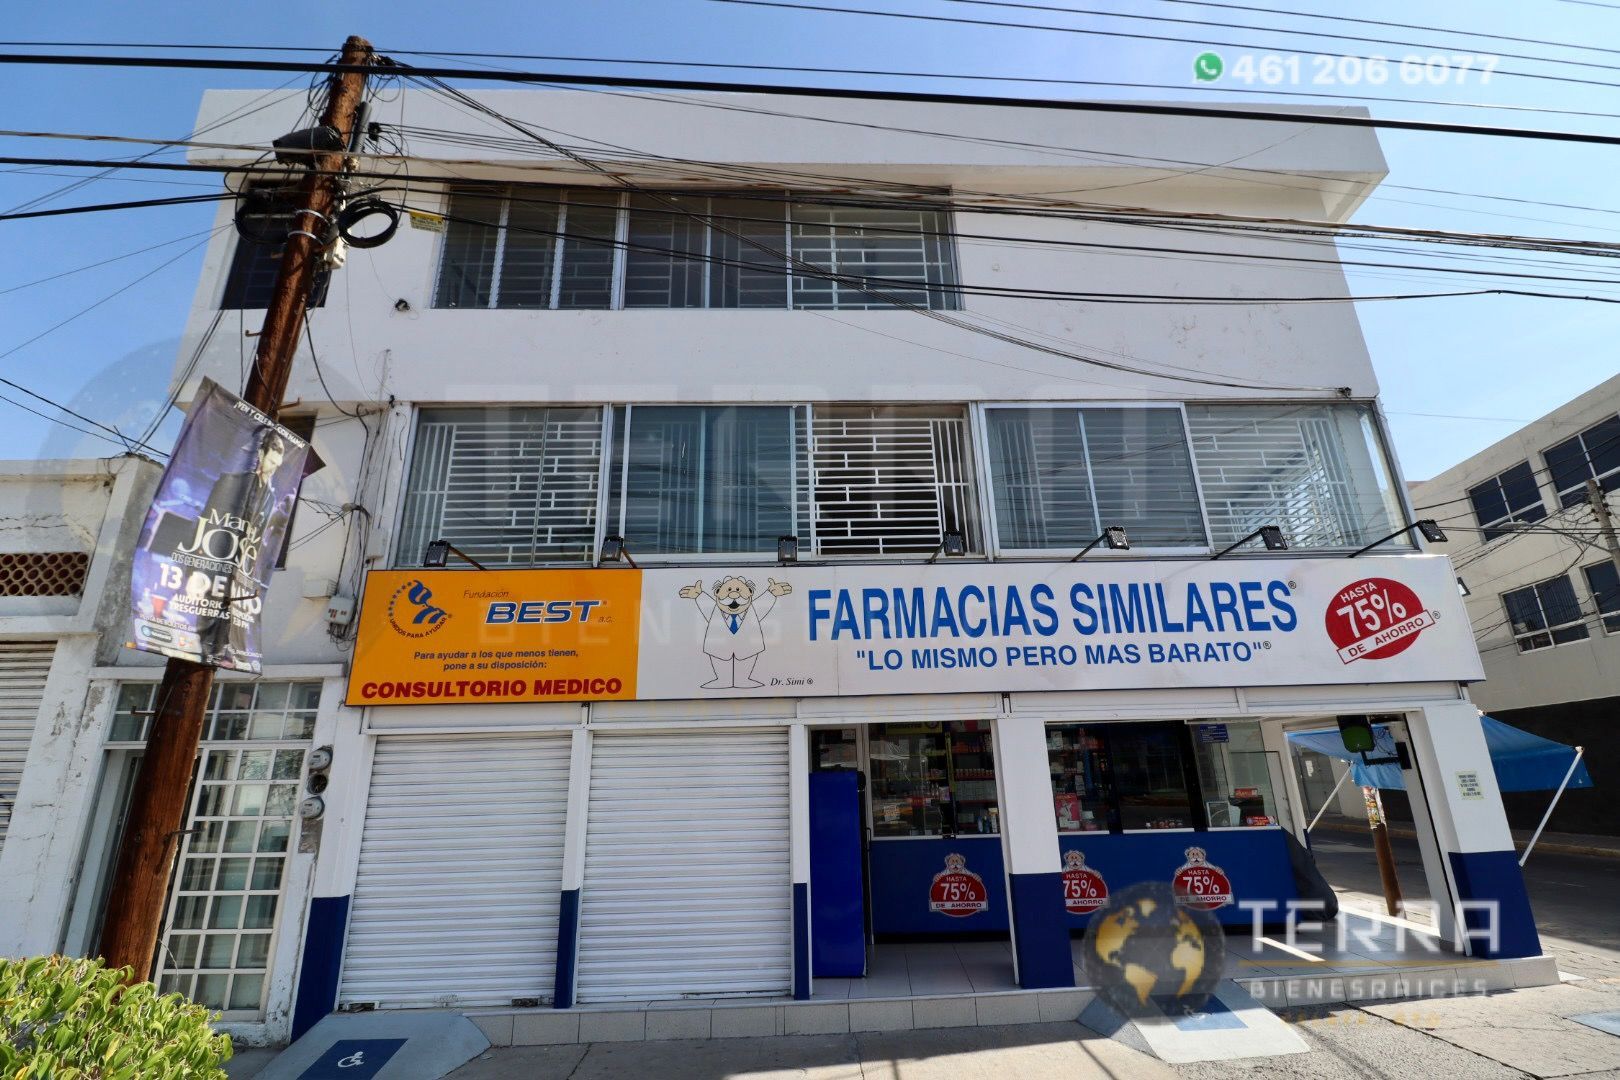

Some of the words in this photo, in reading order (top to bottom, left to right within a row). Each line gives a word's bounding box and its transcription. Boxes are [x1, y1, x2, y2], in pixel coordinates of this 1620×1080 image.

[160, 562, 184, 590] 13
[1340, 581, 1377, 602] HASTA
[485, 600, 602, 624] BEST
[808, 583, 1059, 641] FARMACIAS
[1069, 579, 1298, 637] SIMILARES
[1336, 588, 1407, 639] 75%
[425, 617, 447, 637] AYUDAR
[1347, 643, 1367, 657] DE
[1374, 617, 1424, 646] AHORRO
[414, 651, 435, 660] Para
[437, 650, 470, 661] ayudar
[479, 650, 493, 658] los
[495, 651, 513, 661] que
[515, 650, 546, 658] menos
[911, 646, 998, 669] MISMO
[1005, 644, 1077, 667] PERO
[1086, 644, 1141, 665] MAS
[443, 662, 466, 671] pone
[361, 680, 527, 699] CONSULTORIO
[533, 678, 622, 696] MEDICO
[771, 677, 784, 686] Dr.
[785, 677, 805, 686] Simi
[940, 882, 976, 901] 75%
[1062, 879, 1097, 898] 75%
[1183, 876, 1220, 894] 75%
